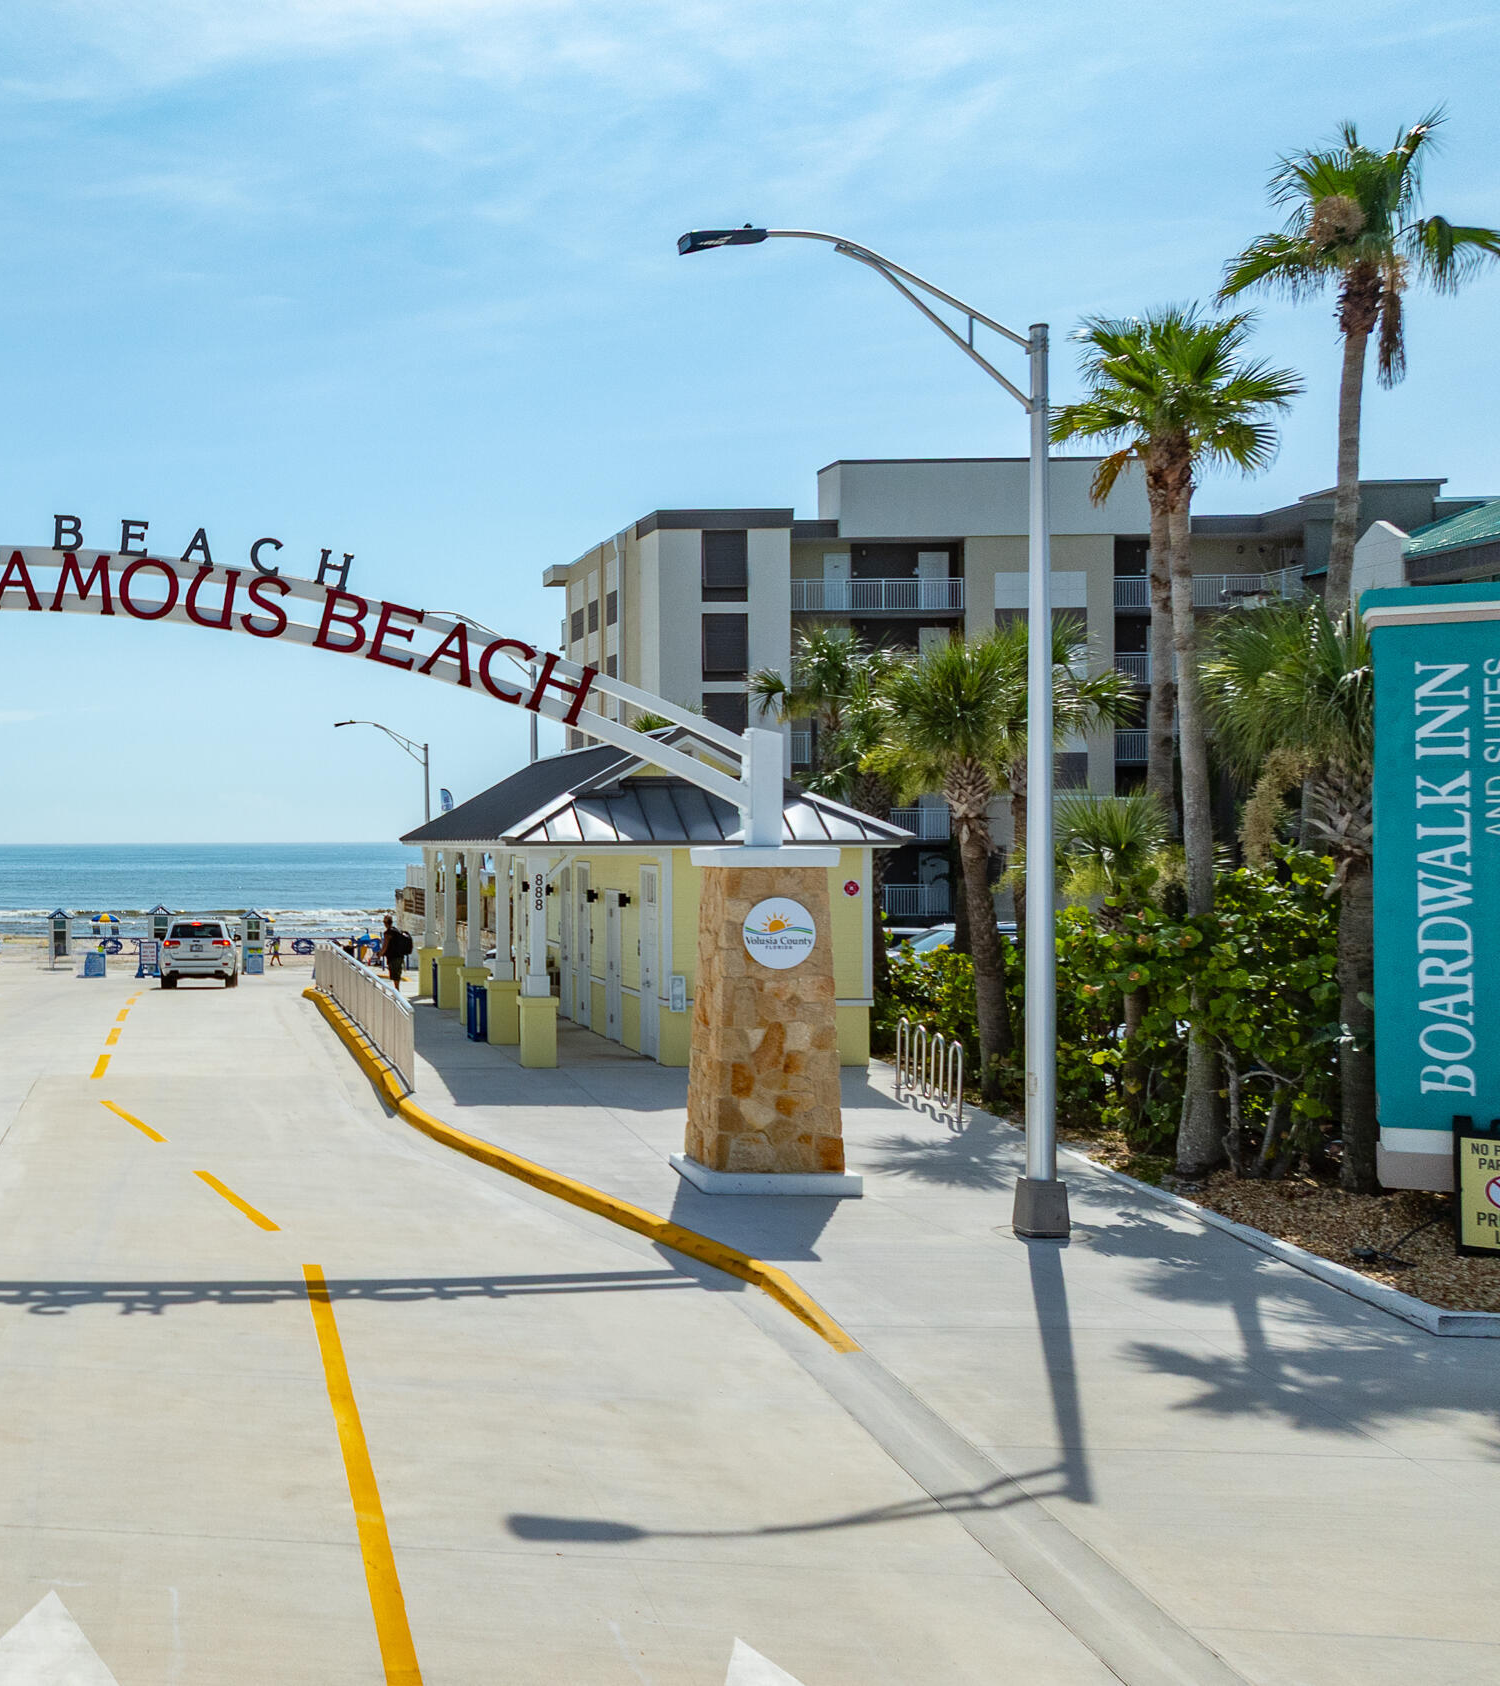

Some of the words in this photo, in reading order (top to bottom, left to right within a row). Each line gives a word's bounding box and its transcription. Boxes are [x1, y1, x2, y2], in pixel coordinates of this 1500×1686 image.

[52, 514, 355, 591] BEACH
[313, 588, 598, 727] BEACH
[1414, 661, 1470, 760] INN
[535, 873, 543, 911] 888
[746, 936, 778, 945] Volusia
[780, 936, 813, 948] County
[1416, 770, 1477, 1096] BOARDWALK
[1471, 1143, 1488, 1156] NO
